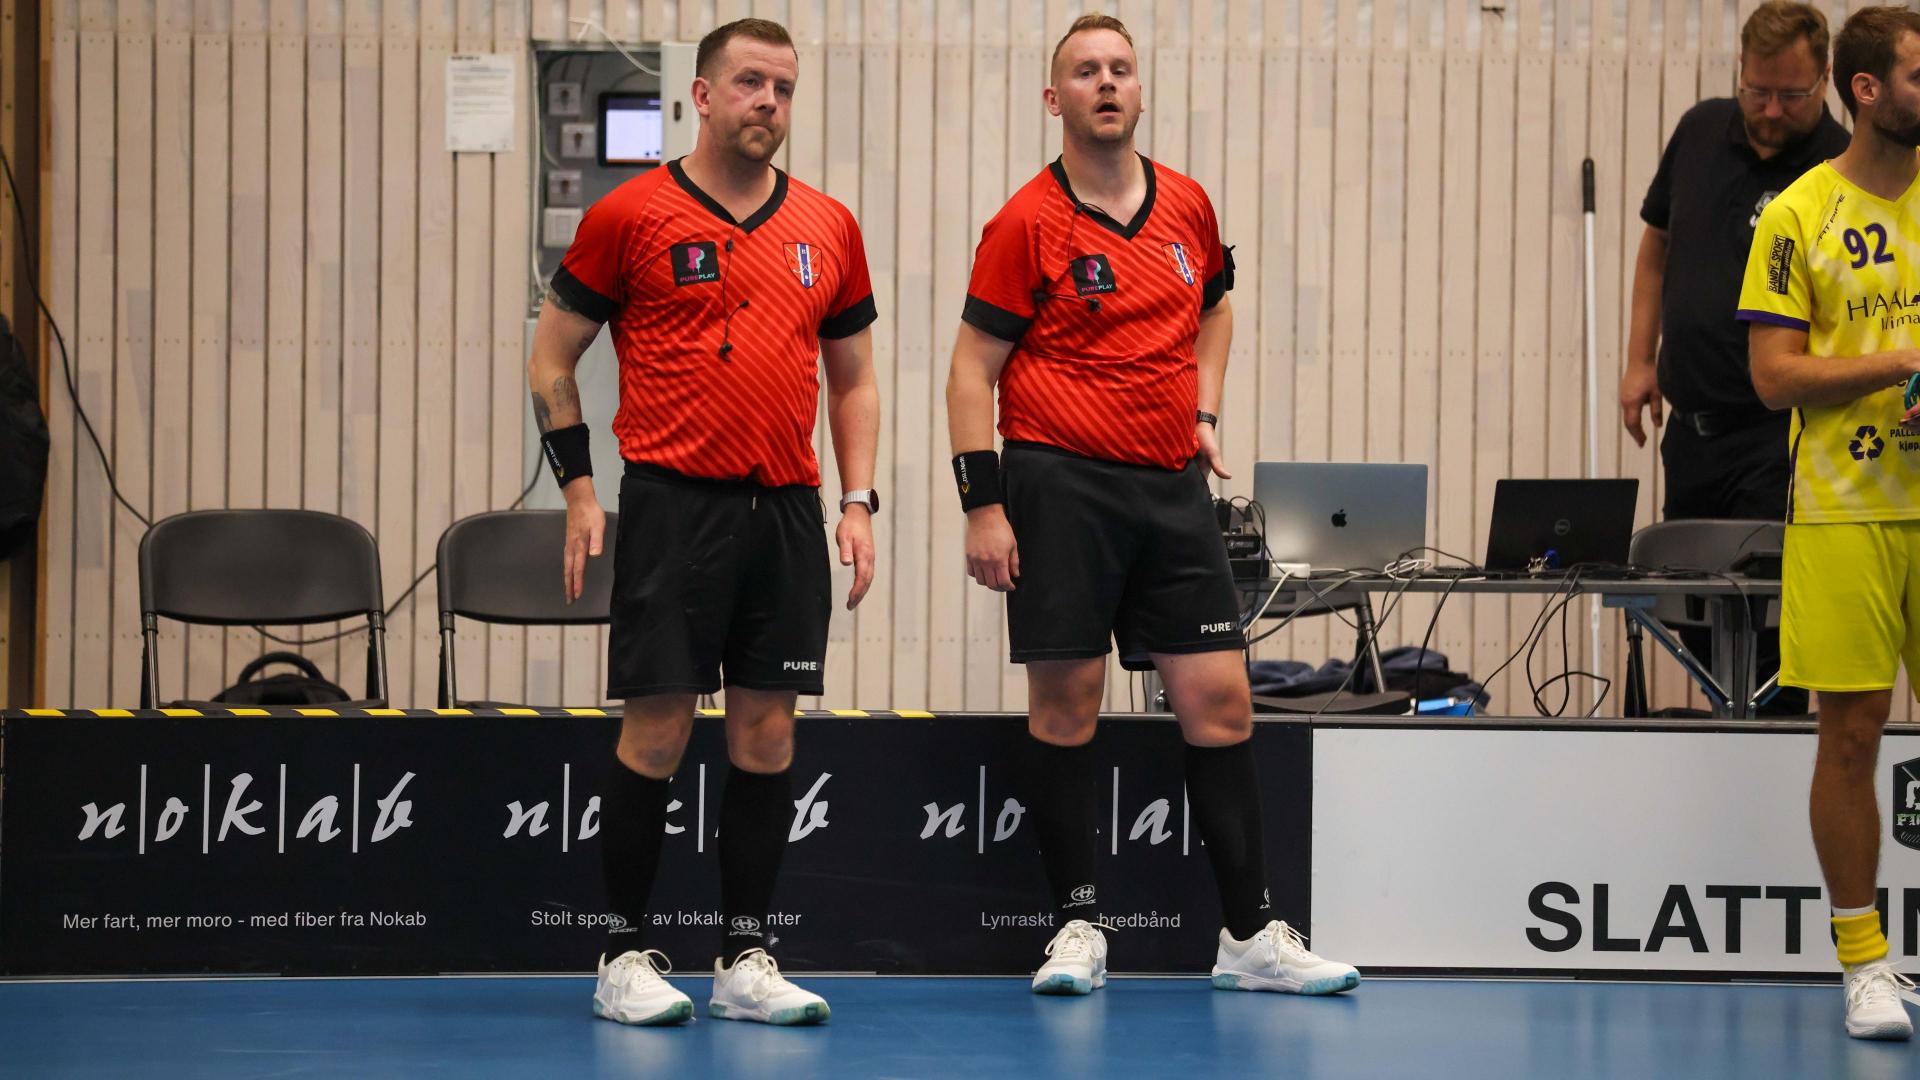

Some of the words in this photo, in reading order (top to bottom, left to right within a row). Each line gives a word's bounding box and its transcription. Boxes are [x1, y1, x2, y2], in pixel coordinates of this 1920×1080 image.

[1843, 222, 1894, 269] 92
[63, 914, 98, 929] Mer
[103, 913, 140, 931] fart,
[146, 916, 181, 928] mer
[186, 916, 232, 928] moro
[250, 912, 289, 927] med
[294, 911, 335, 927] fiber
[340, 911, 365, 927] fra
[370, 911, 427, 926] Nokab
[531, 910, 573, 926] Stolt
[652, 913, 673, 926] av
[981, 912, 1054, 931] Lynraskt
